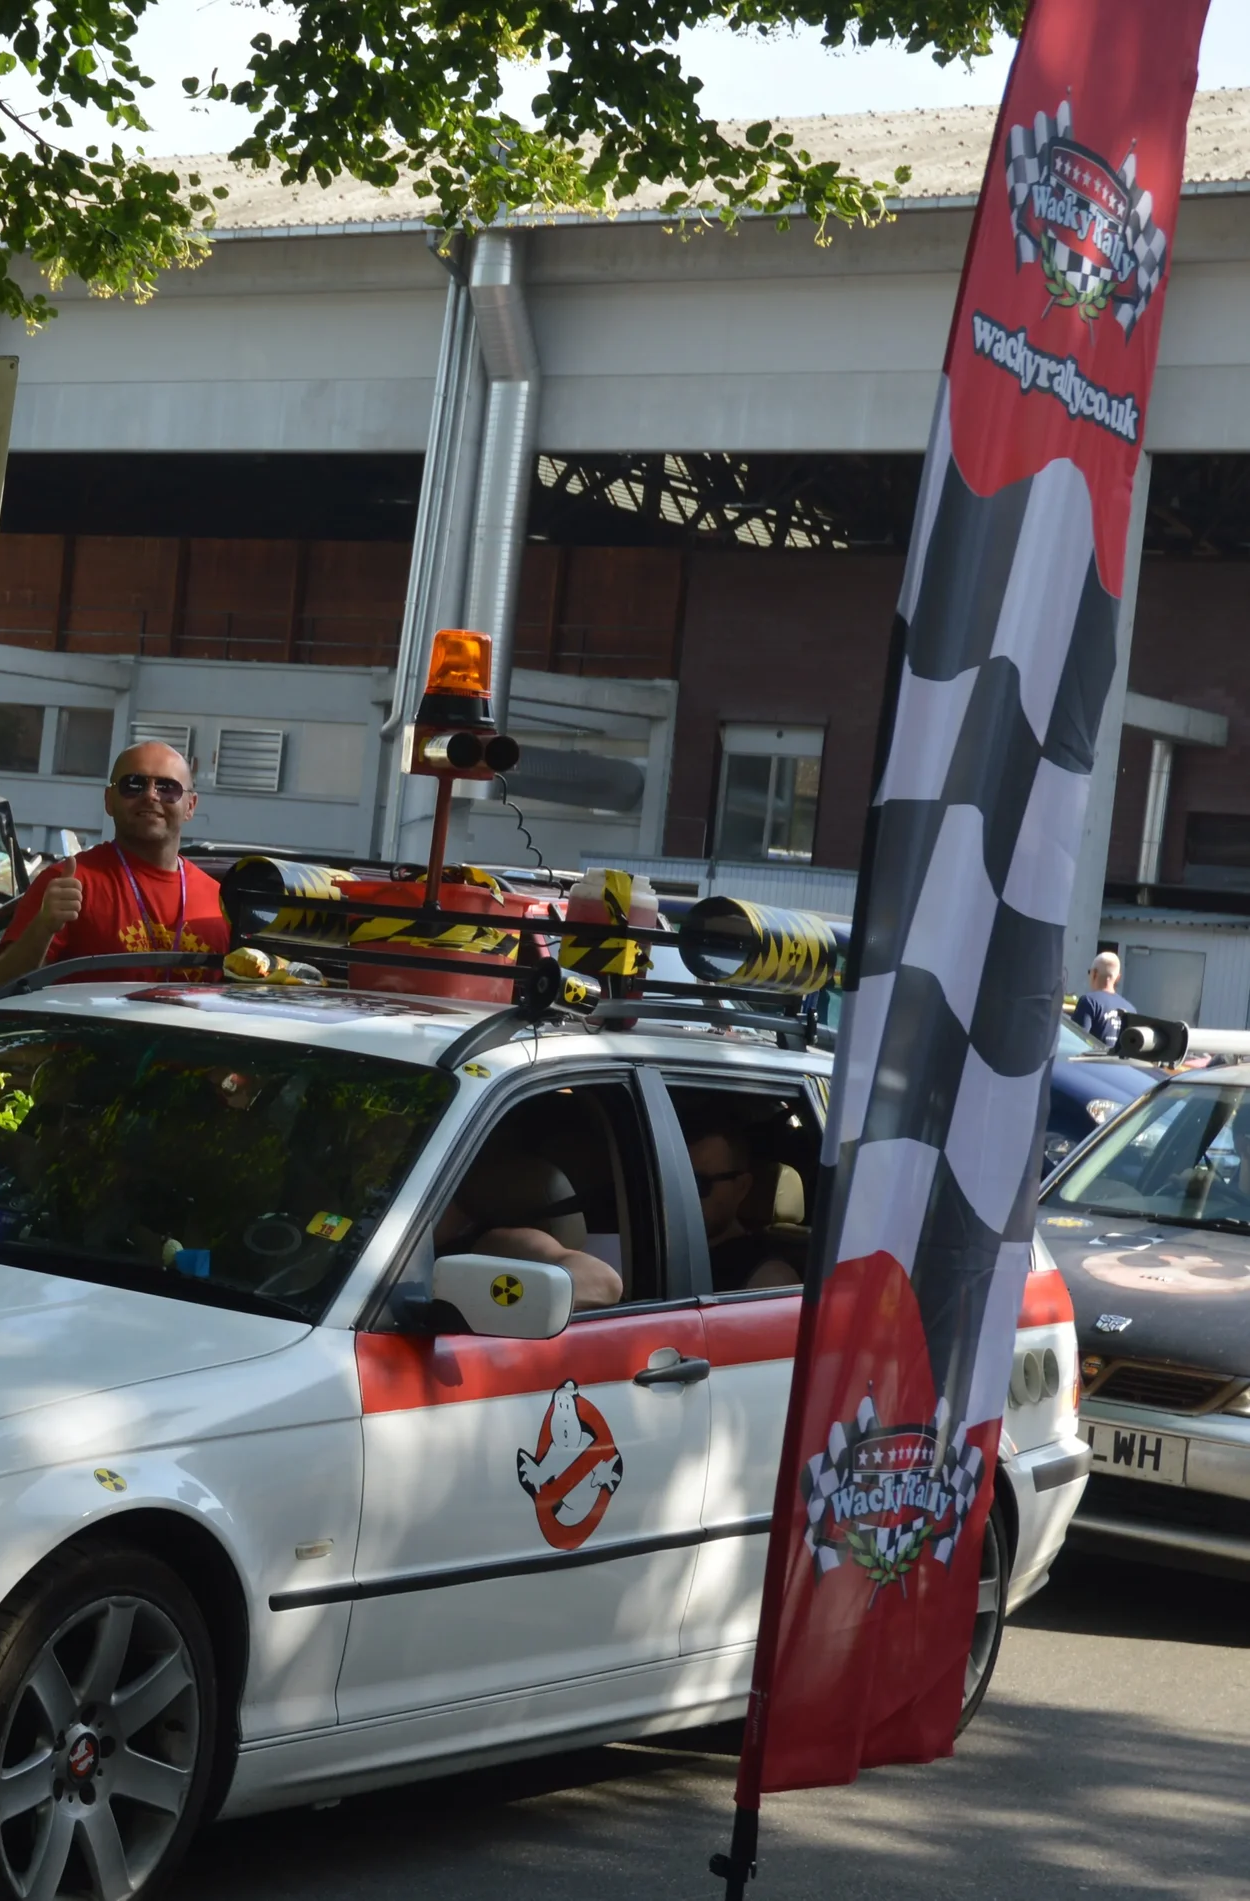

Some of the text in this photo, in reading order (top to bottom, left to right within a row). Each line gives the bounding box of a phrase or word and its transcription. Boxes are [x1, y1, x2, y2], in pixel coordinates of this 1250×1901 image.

[1032, 183, 1136, 283] Wacky Rally
[831, 1470, 952, 1522] Wacky Rally
